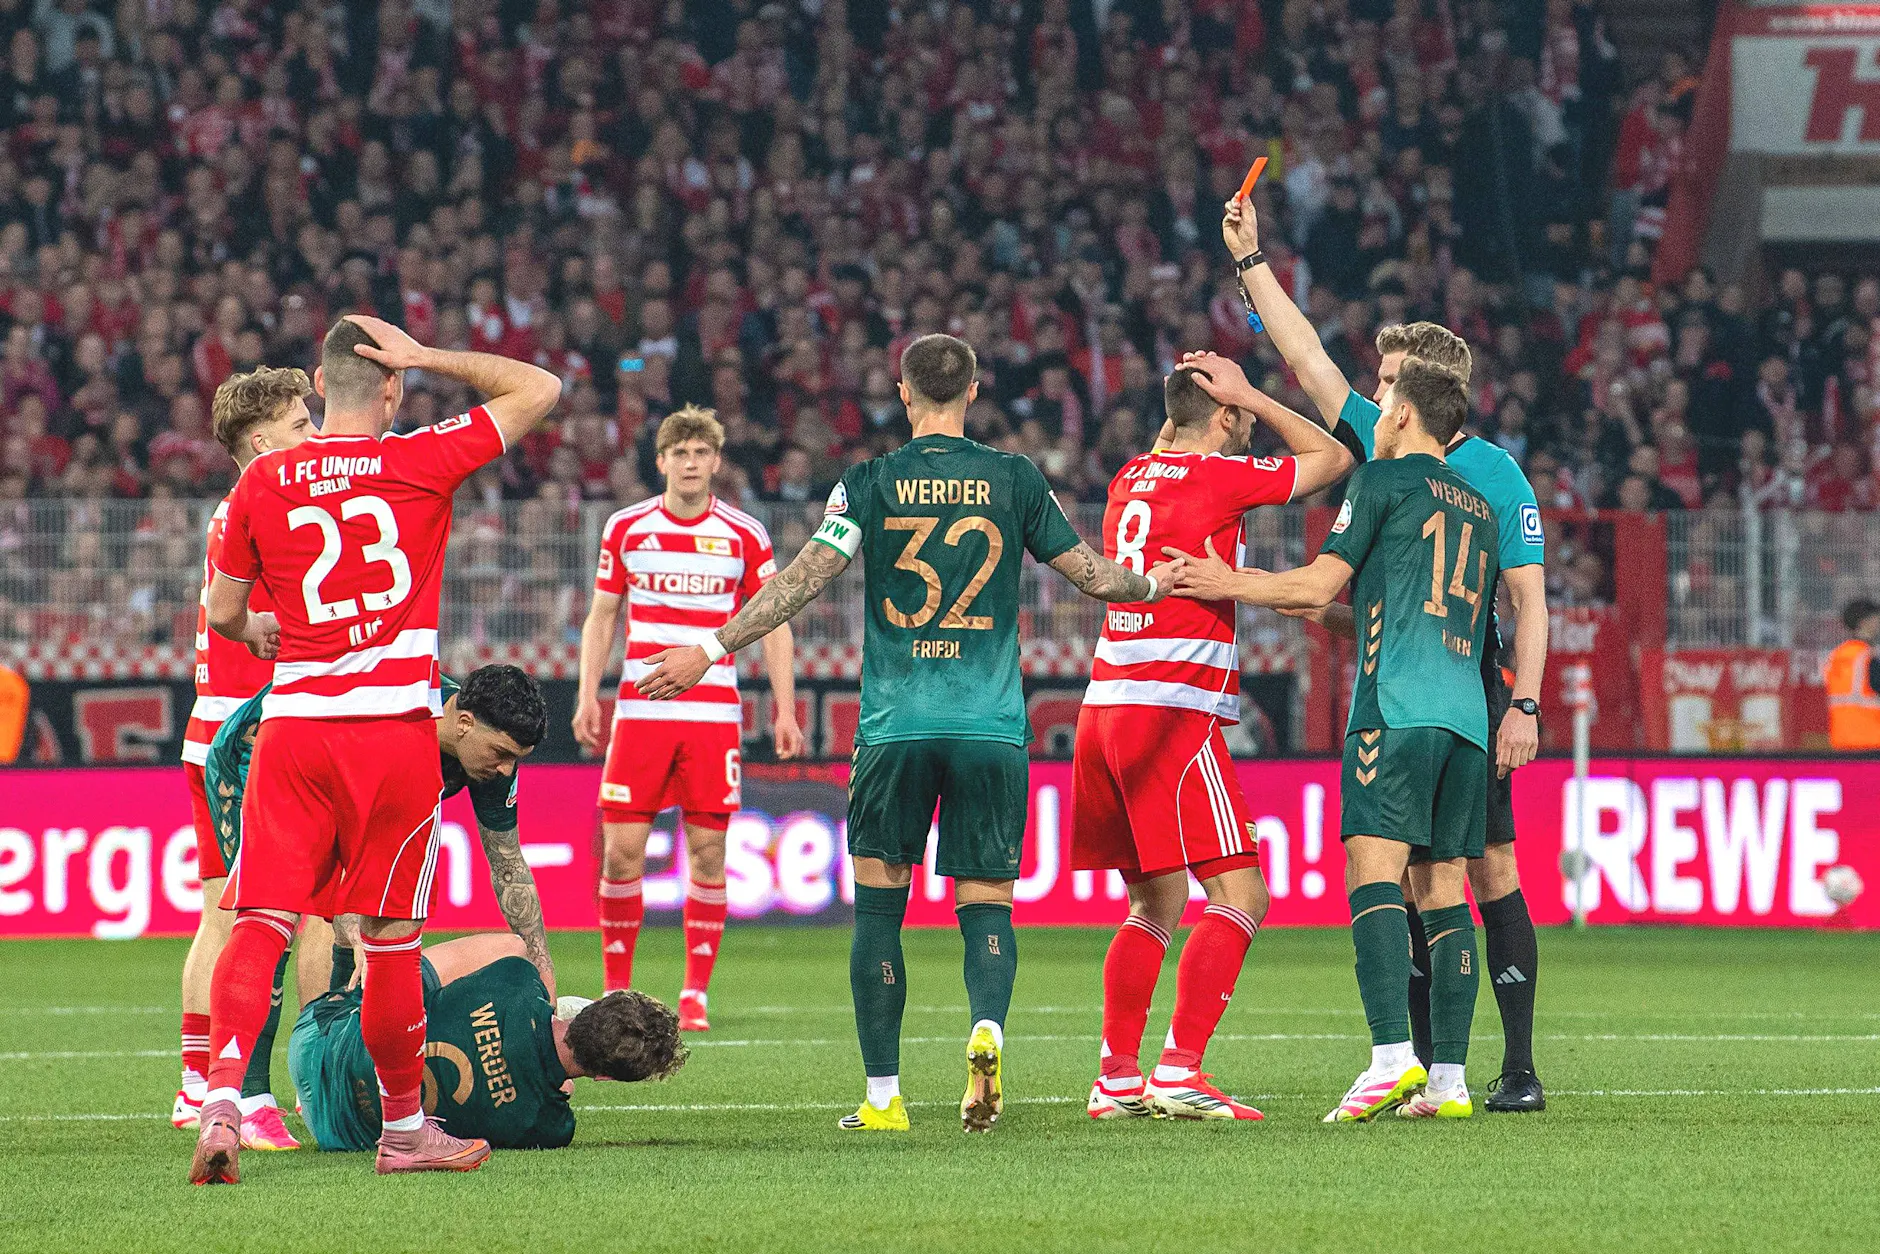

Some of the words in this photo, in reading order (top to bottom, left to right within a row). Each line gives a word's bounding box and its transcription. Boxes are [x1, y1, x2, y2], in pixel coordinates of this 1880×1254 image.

[277, 464, 291, 486] 1.
[295, 459, 317, 483] FC
[321, 455, 382, 477] UNION
[309, 476, 351, 498] BERLIN
[896, 479, 991, 505] WERDER
[1424, 477, 1492, 523] WERDER
[286, 495, 412, 625] 23
[652, 568, 727, 594] raisin
[883, 516, 1003, 630] 32
[1422, 510, 1489, 634] 14
[912, 640, 962, 660] FRIEDL
[725, 749, 741, 787] 6
[1563, 777, 1843, 917] REWE
[469, 1002, 518, 1109] WERDER
